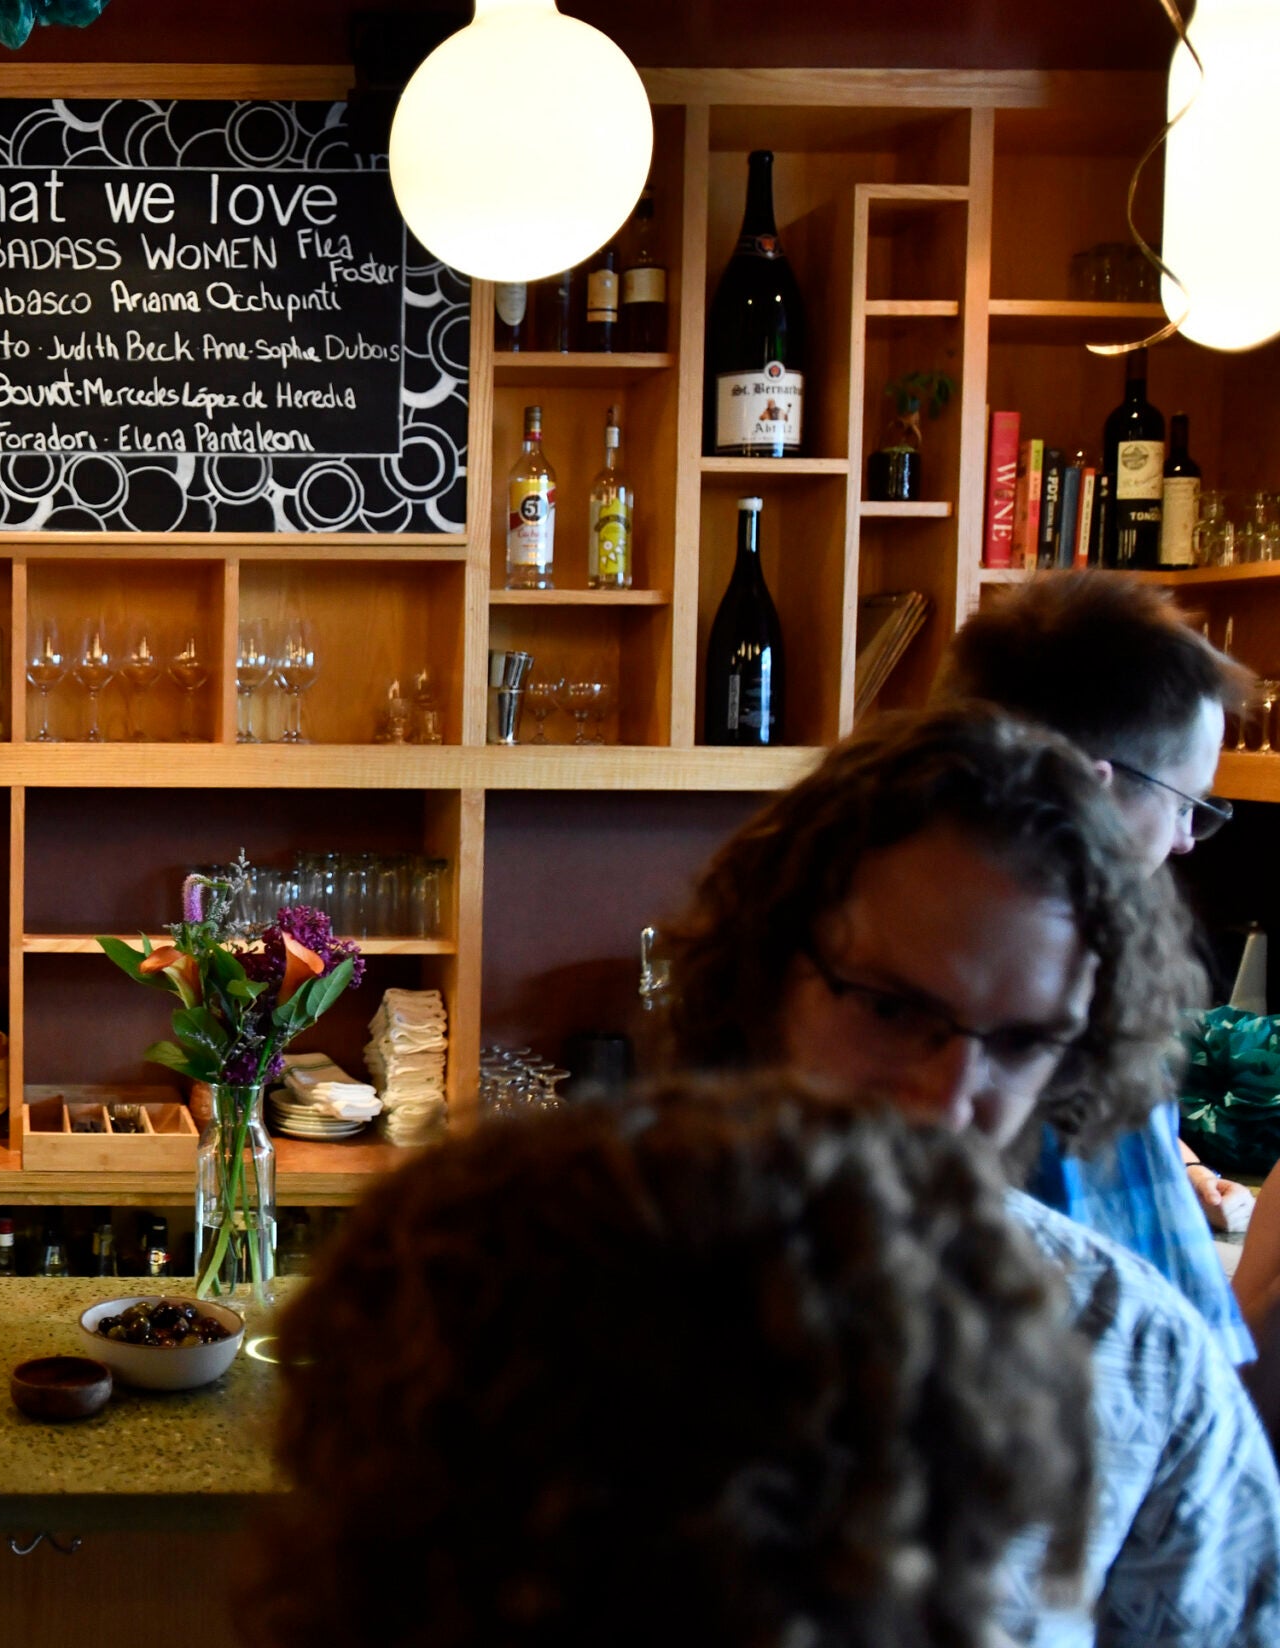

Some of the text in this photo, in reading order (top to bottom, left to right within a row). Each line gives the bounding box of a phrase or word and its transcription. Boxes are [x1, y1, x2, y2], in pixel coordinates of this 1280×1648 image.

[104, 181, 175, 223] we
[210, 173, 338, 226] love
[141, 232, 278, 270] WOMEN
[297, 228, 354, 261] Flea
[329, 252, 400, 285] Foster
[111, 279, 201, 312] Arianna
[206, 281, 342, 322] Occhipinti
[46, 331, 121, 361] Judith
[126, 330, 195, 361] Beck
[325, 332, 401, 362] Dubois
[82, 376, 180, 406] Mercedes
[243, 381, 268, 409] de
[276, 381, 357, 410] Heredia
[119, 423, 187, 452] Elena
[195, 421, 316, 452] Pantaleoni
